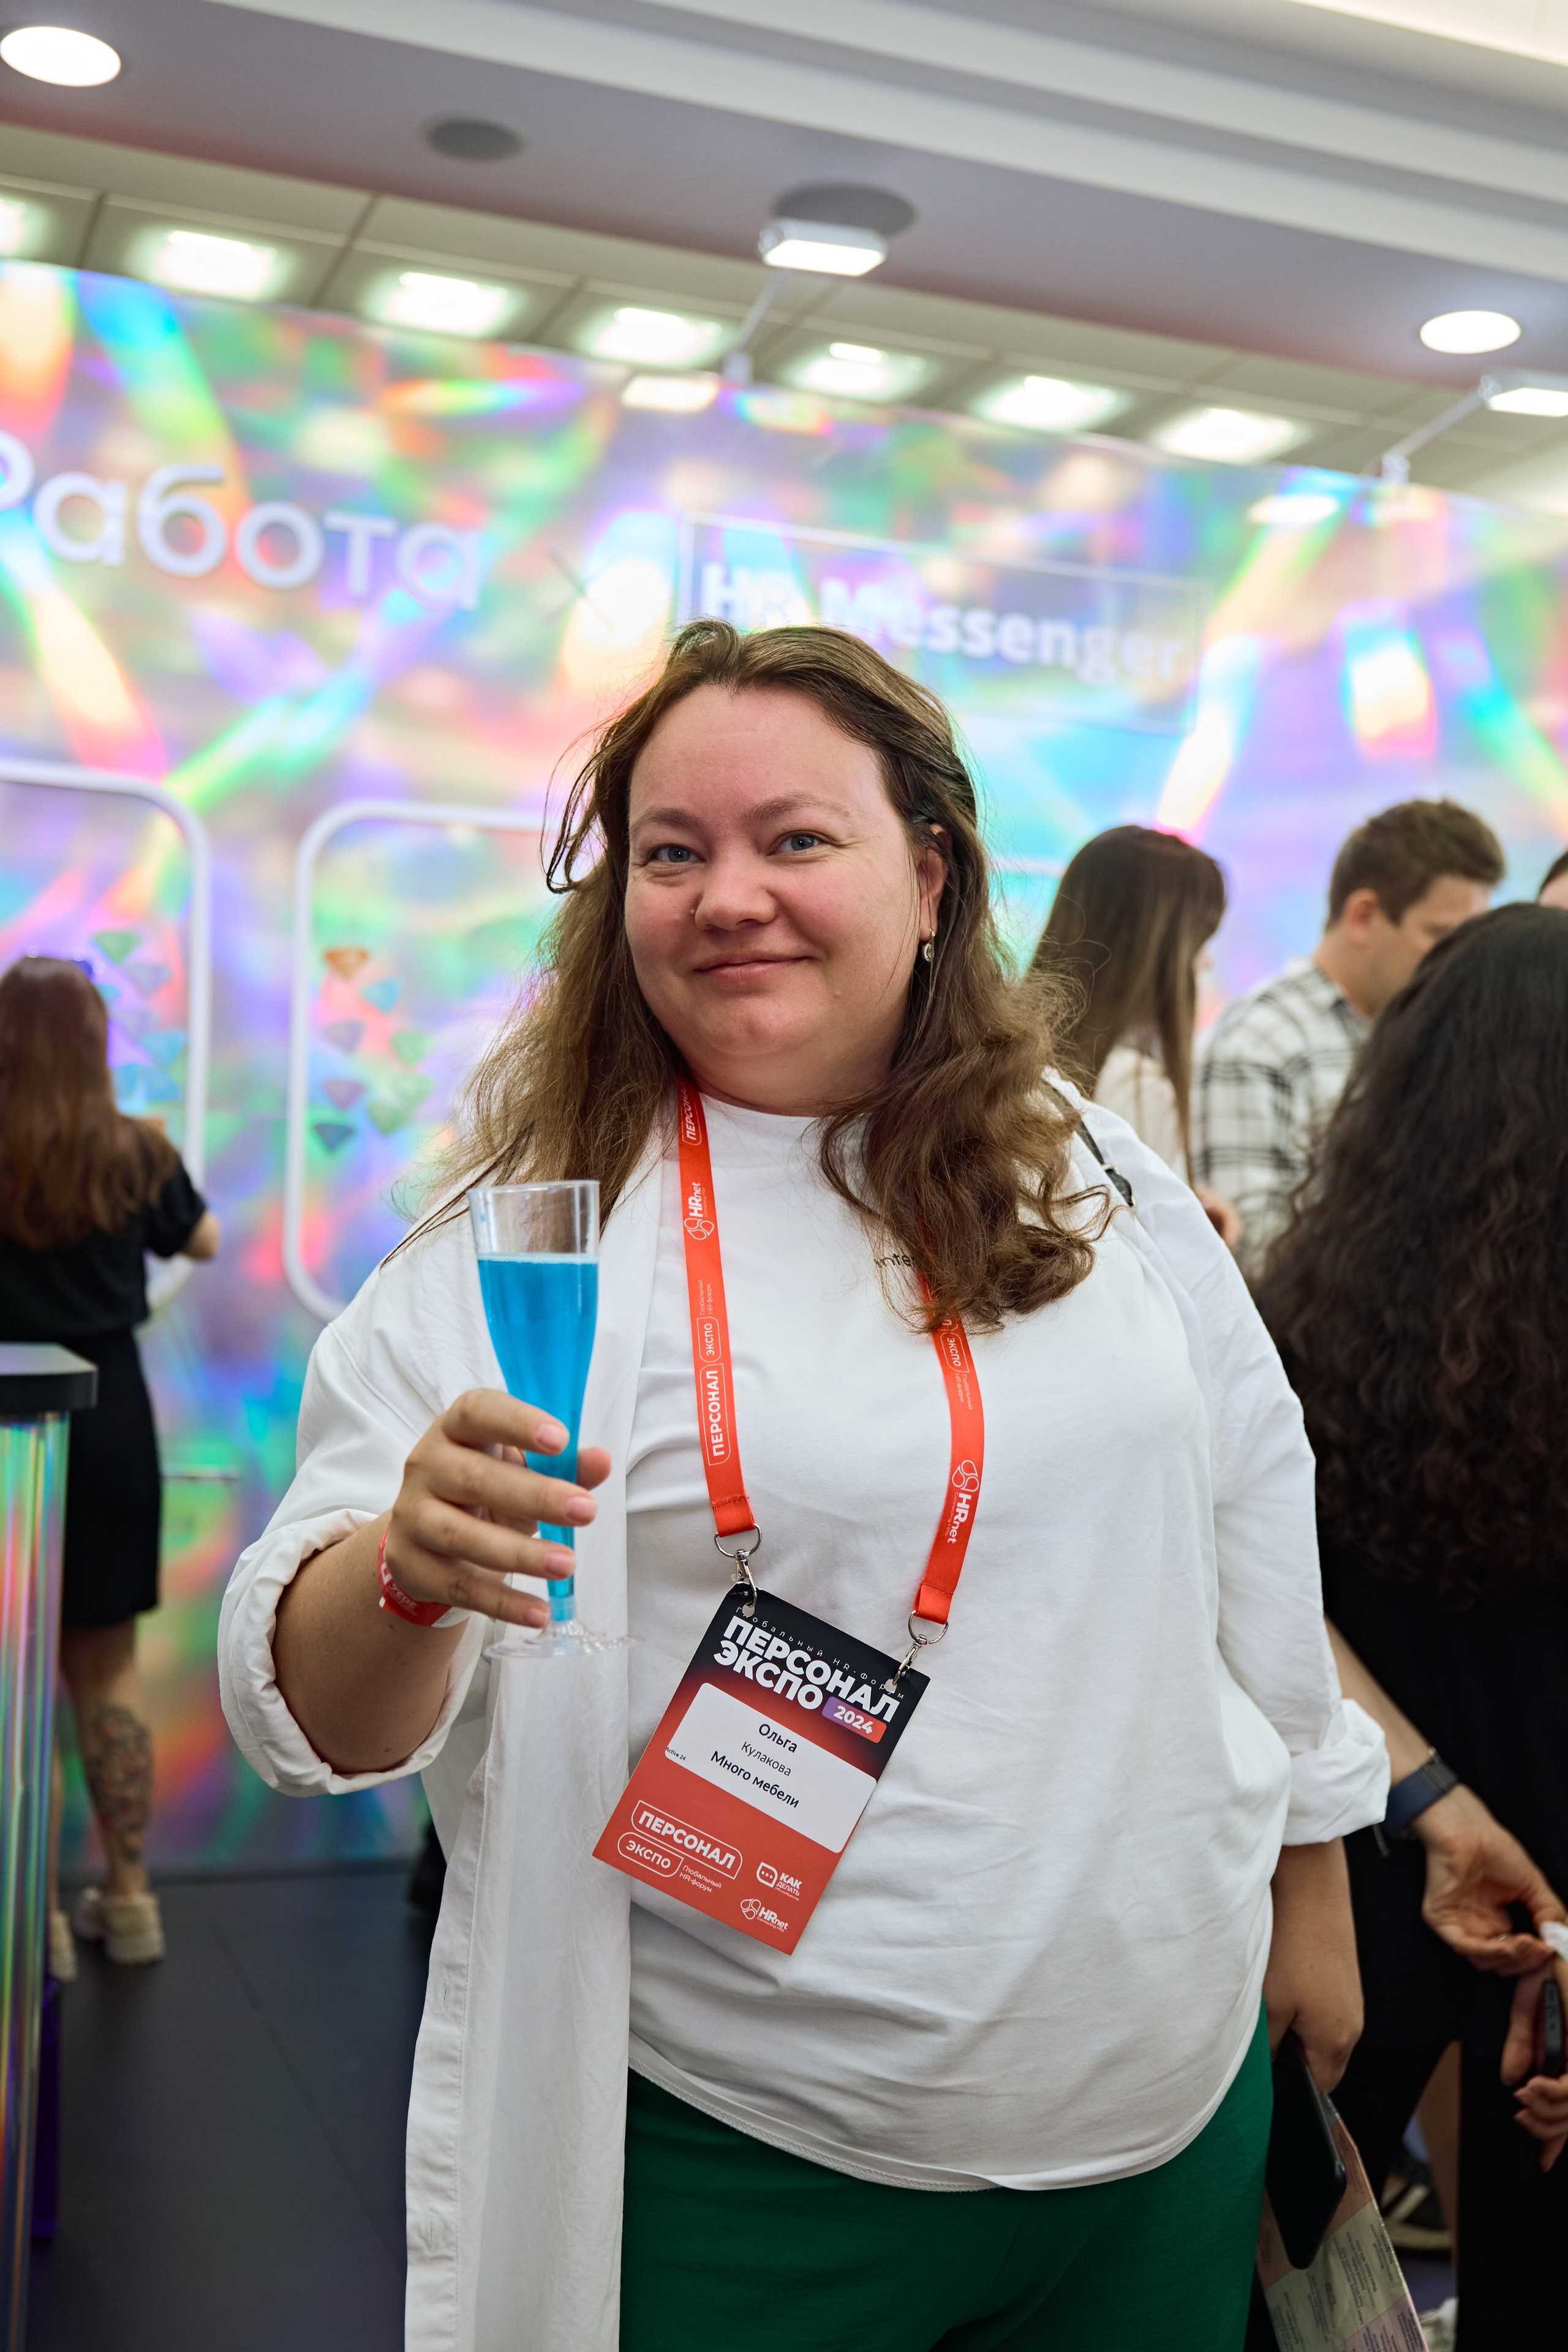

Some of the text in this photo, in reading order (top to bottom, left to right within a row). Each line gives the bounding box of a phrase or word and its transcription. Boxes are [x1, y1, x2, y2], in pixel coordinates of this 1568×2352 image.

[820, 576, 1185, 681] Messenger
[688, 1182, 703, 1218] HRnet
[704, 1323, 715, 1356] ЭКСПО
[947, 1337, 962, 1367] ЭКСПО
[954, 1373, 964, 1403] HR-форум
[962, 1374, 973, 1411] Глобальный
[706, 1370, 725, 1457] ПЕРСОНАЛ
[947, 1493, 972, 1544] HRnet
[736, 1607, 823, 1657] Гобальный
[714, 1640, 823, 1709] ЭКСПО
[723, 1615, 900, 1722] ПЕРСОНАЛ
[833, 1705, 873, 1734] 2024
[666, 1747, 679, 1757] Active
[758, 1724, 797, 1753] Ольга
[741, 1741, 791, 1776] Кулакова
[710, 1751, 799, 1808] Много мебели
[626, 1840, 671, 1869] ЭКСПО
[638, 1811, 736, 1869] ПЕРСОНАЛ
[679, 1872, 712, 1893] HR-форум
[682, 1864, 722, 1889] Глобальный
[776, 1881, 800, 1896] ДЕЛАТЬ
[780, 1872, 802, 1890] КАК
[758, 1907, 788, 1930] HRnet
